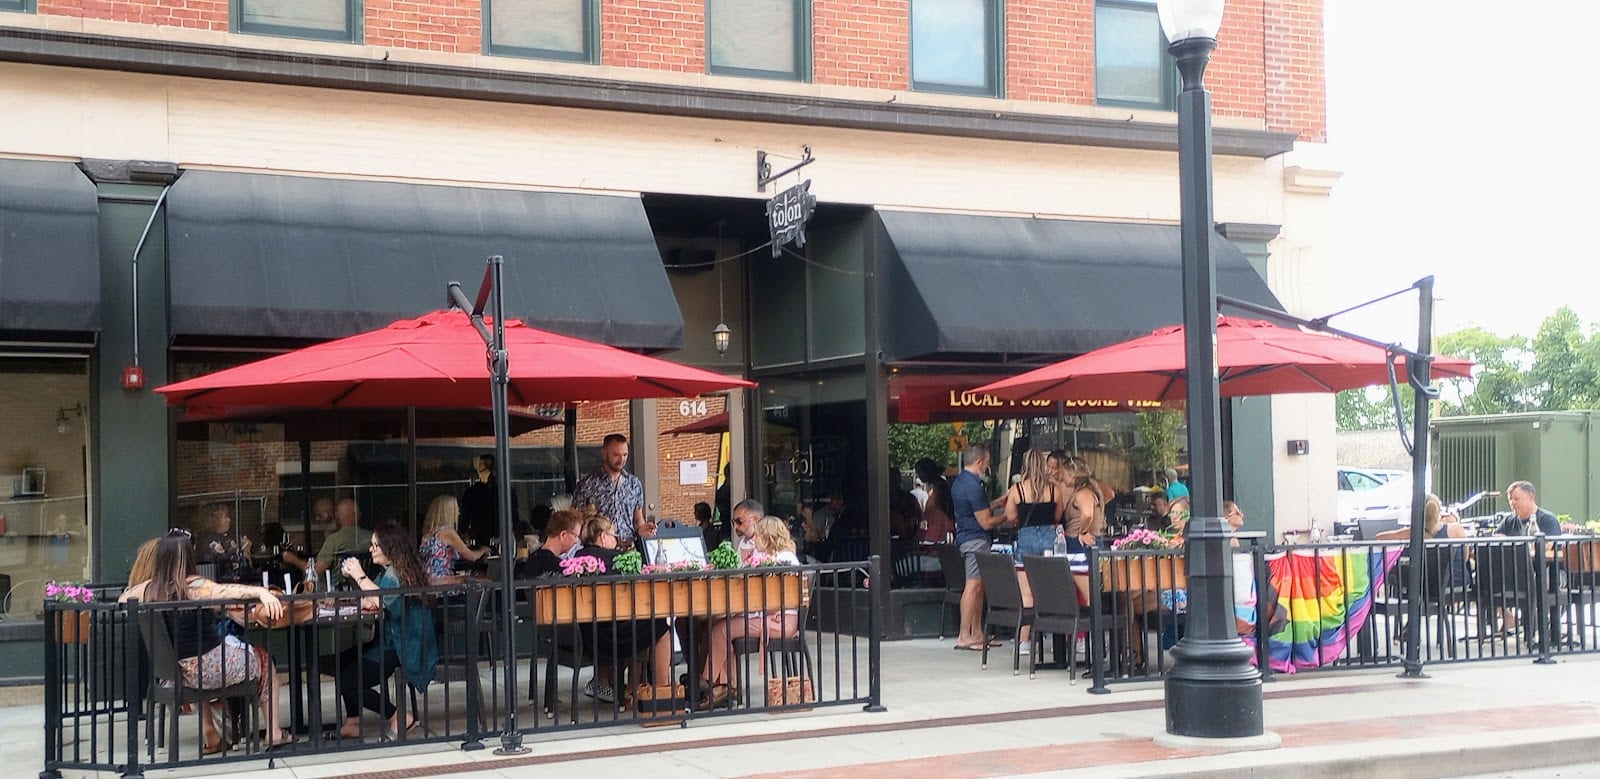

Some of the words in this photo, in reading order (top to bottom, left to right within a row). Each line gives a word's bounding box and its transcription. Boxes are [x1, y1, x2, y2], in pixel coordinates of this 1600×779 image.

[772, 193, 802, 228] tolon
[950, 390, 1004, 406] LOCAL
[680, 400, 707, 416] 614
